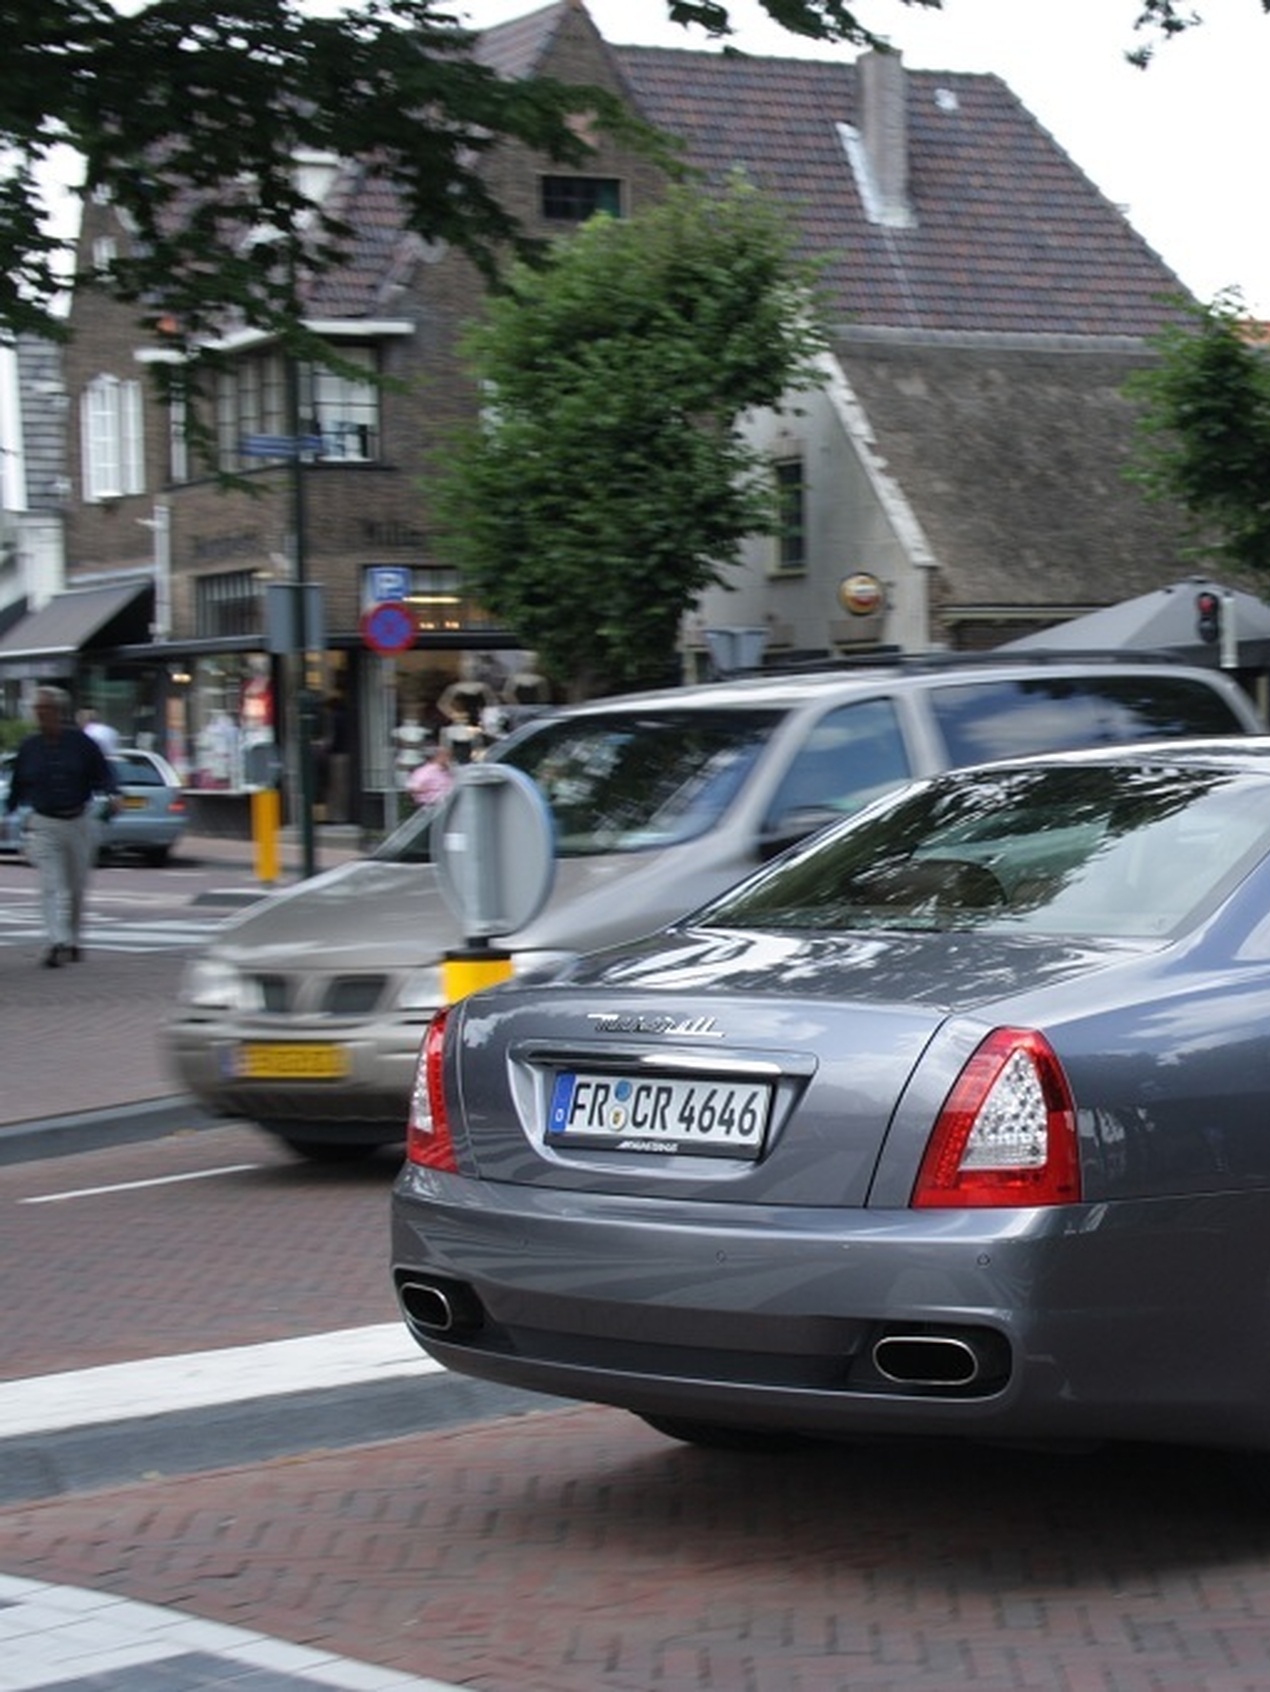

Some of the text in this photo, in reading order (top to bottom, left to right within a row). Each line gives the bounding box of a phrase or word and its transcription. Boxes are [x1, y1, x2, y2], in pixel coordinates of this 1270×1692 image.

[373, 572, 404, 598] P
[569, 1083, 611, 1126] FR
[631, 1085, 673, 1131] CR
[678, 1088, 760, 1137] 4646
